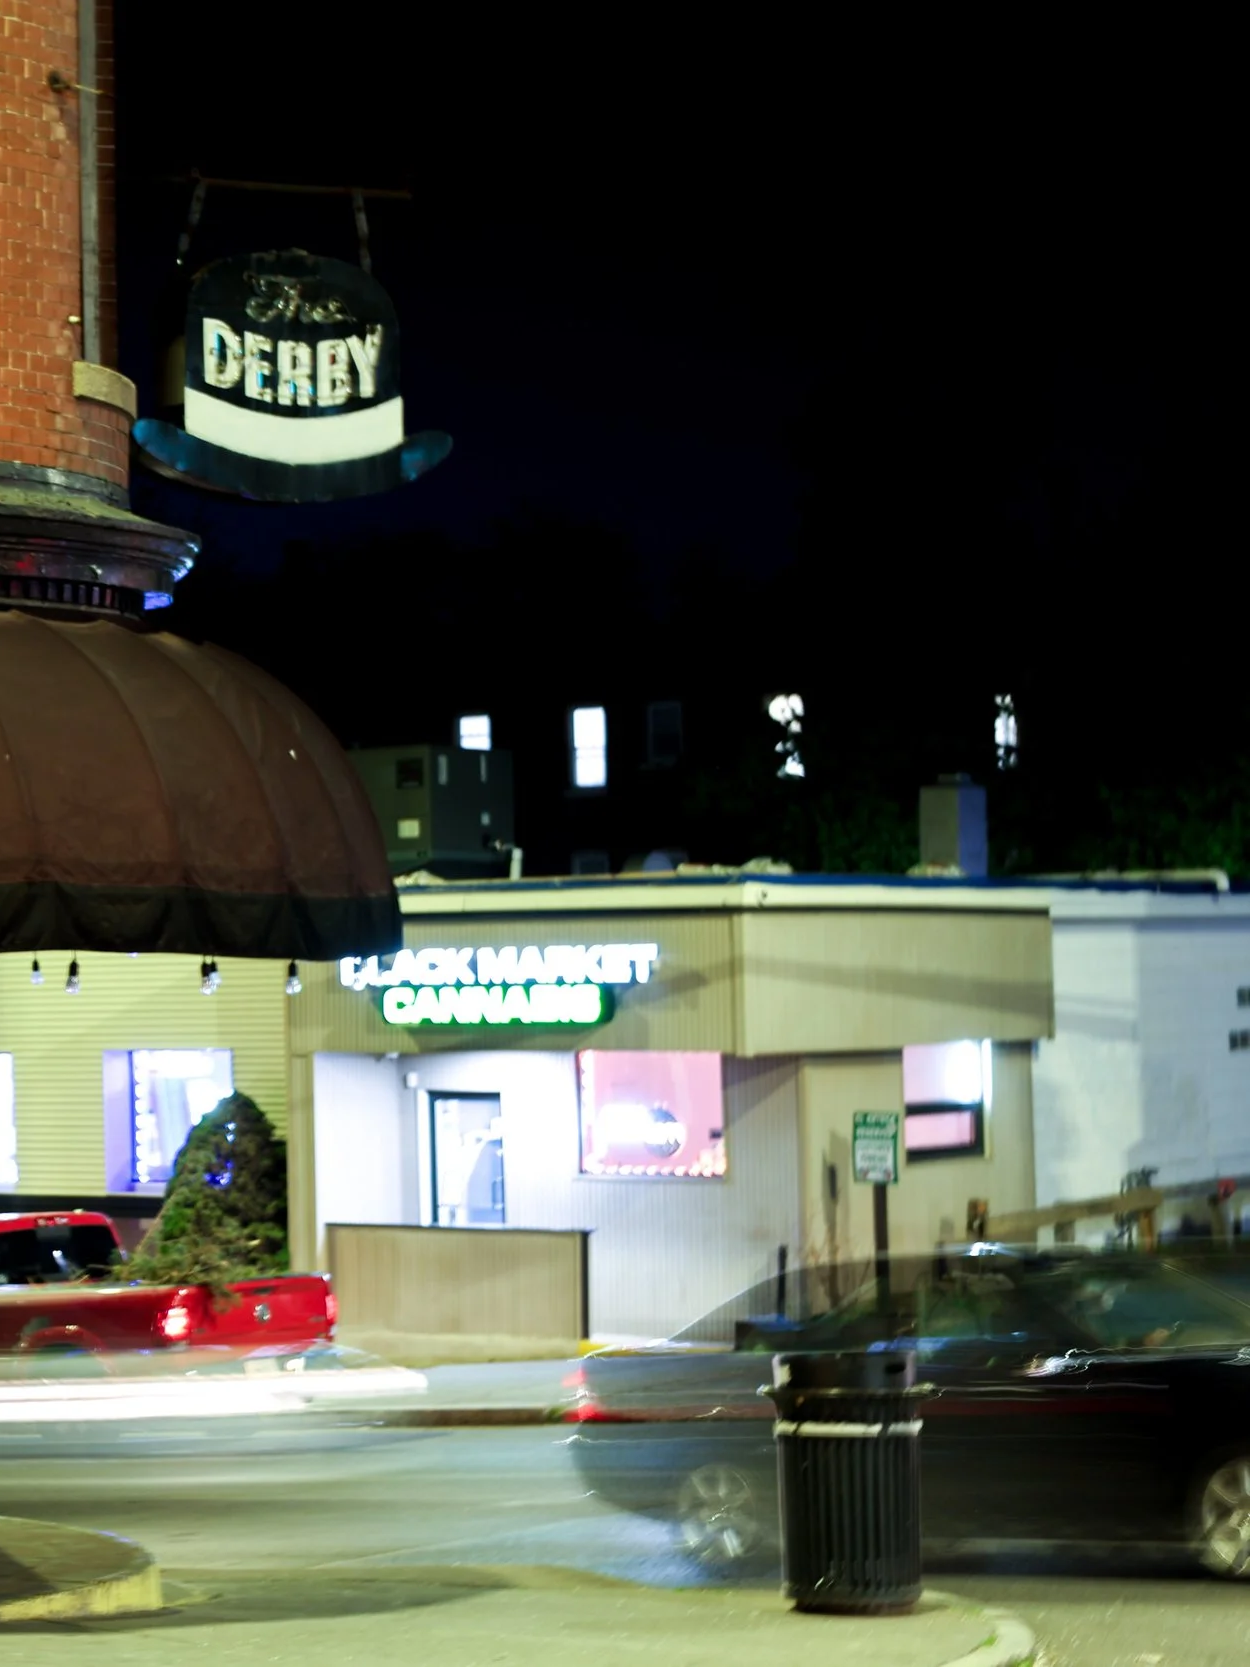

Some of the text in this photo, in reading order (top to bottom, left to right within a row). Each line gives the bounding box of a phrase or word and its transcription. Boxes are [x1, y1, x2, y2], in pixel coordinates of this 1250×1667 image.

[202, 317, 384, 407] DERBY
[477, 943, 659, 986] MARKET
[383, 986, 602, 1024] CANNABIS
